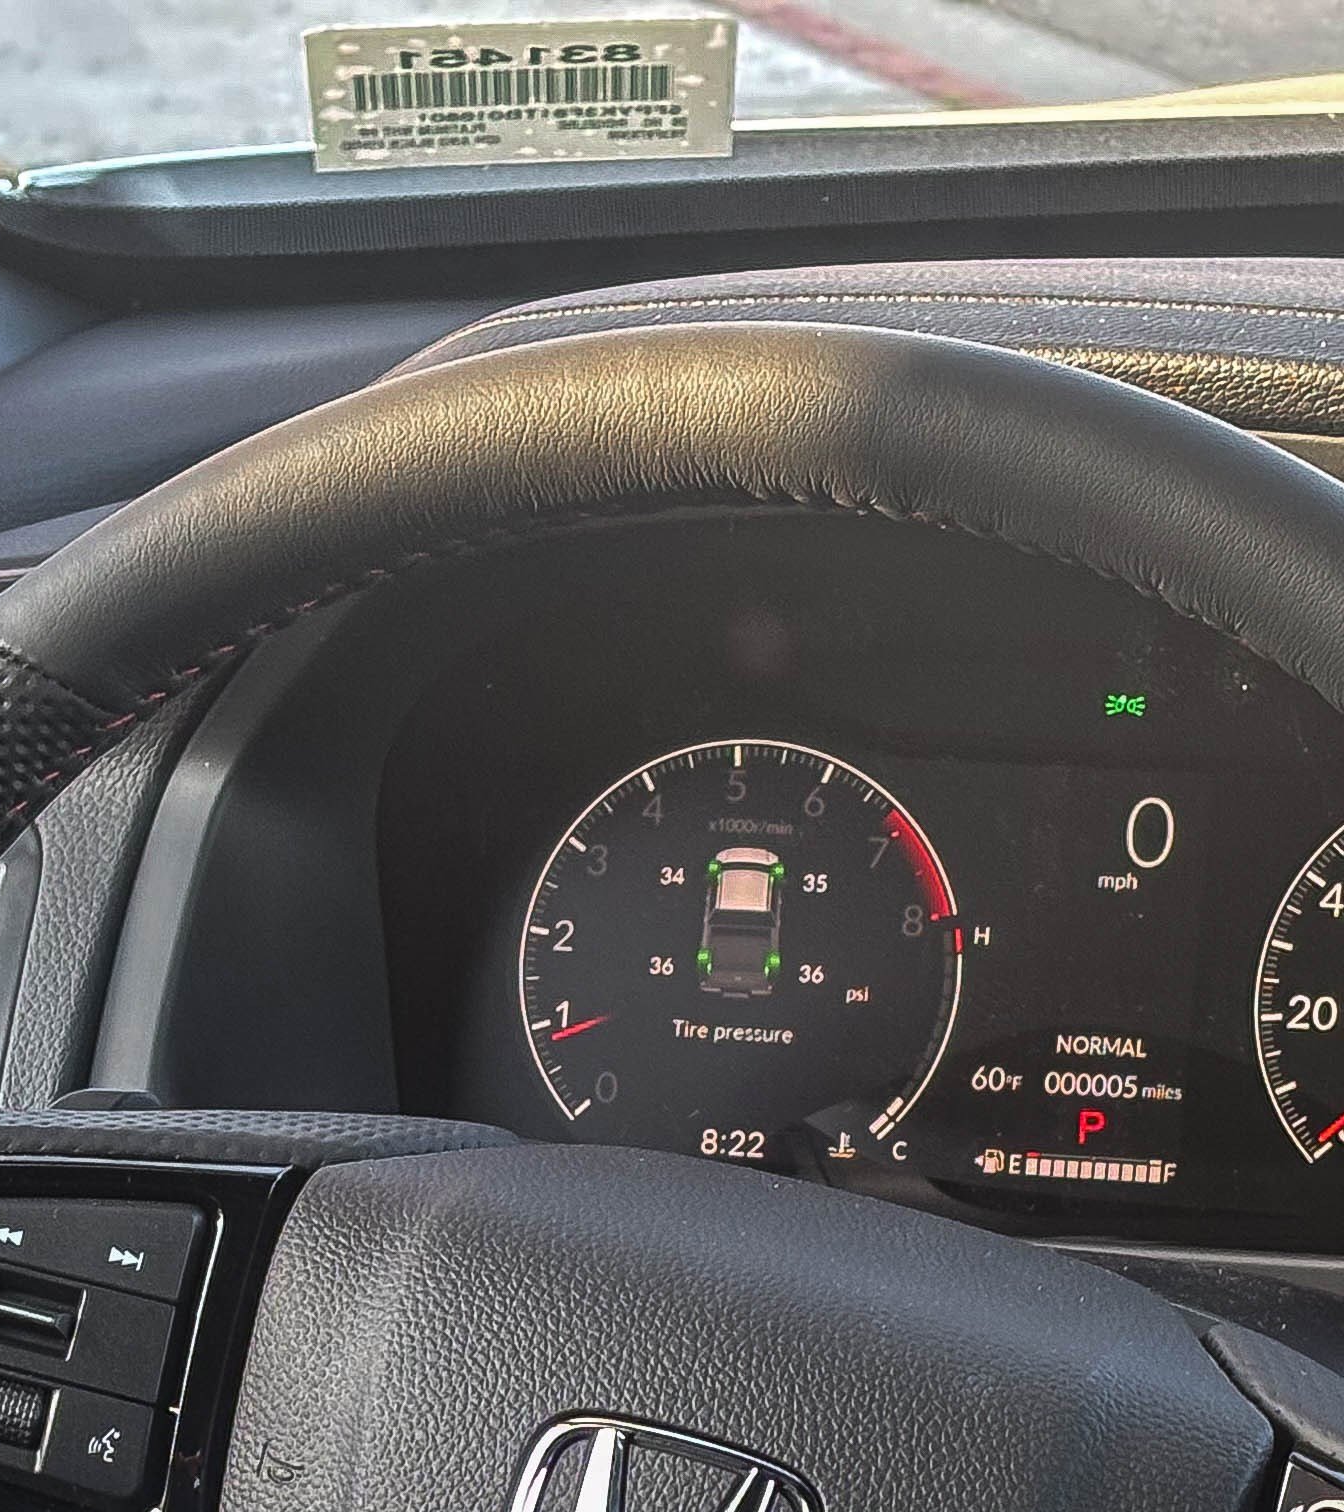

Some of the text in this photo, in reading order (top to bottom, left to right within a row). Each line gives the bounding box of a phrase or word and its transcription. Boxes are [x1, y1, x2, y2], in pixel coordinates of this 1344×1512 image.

[727, 774, 747, 801] 5
[641, 796, 664, 825] 4
[803, 789, 825, 816] 6
[1126, 796, 1174, 868] 0
[586, 844, 608, 875] 3
[867, 836, 891, 868] 7
[659, 867, 686, 886] 34
[802, 873, 829, 894] 35
[1098, 873, 1138, 892] mph
[902, 904, 924, 936] 8
[552, 919, 575, 953] 2
[973, 926, 991, 945] H
[648, 957, 675, 976] 36
[798, 964, 825, 984] 36
[845, 985, 869, 1004] psi
[555, 1000, 570, 1028] 1
[1285, 994, 1339, 1031] 20
[672, 1018, 794, 1044] Tire pressure
[1056, 1033, 1147, 1059] NORMAL
[595, 1072, 618, 1103] 0
[1044, 1071, 1138, 1099] 000005
[1141, 1083, 1183, 1101] miles
[1077, 1108, 1107, 1145] P
[699, 1128, 766, 1159] 8:22
[891, 1140, 908, 1161] C
[1008, 1153, 1177, 1184] E F
